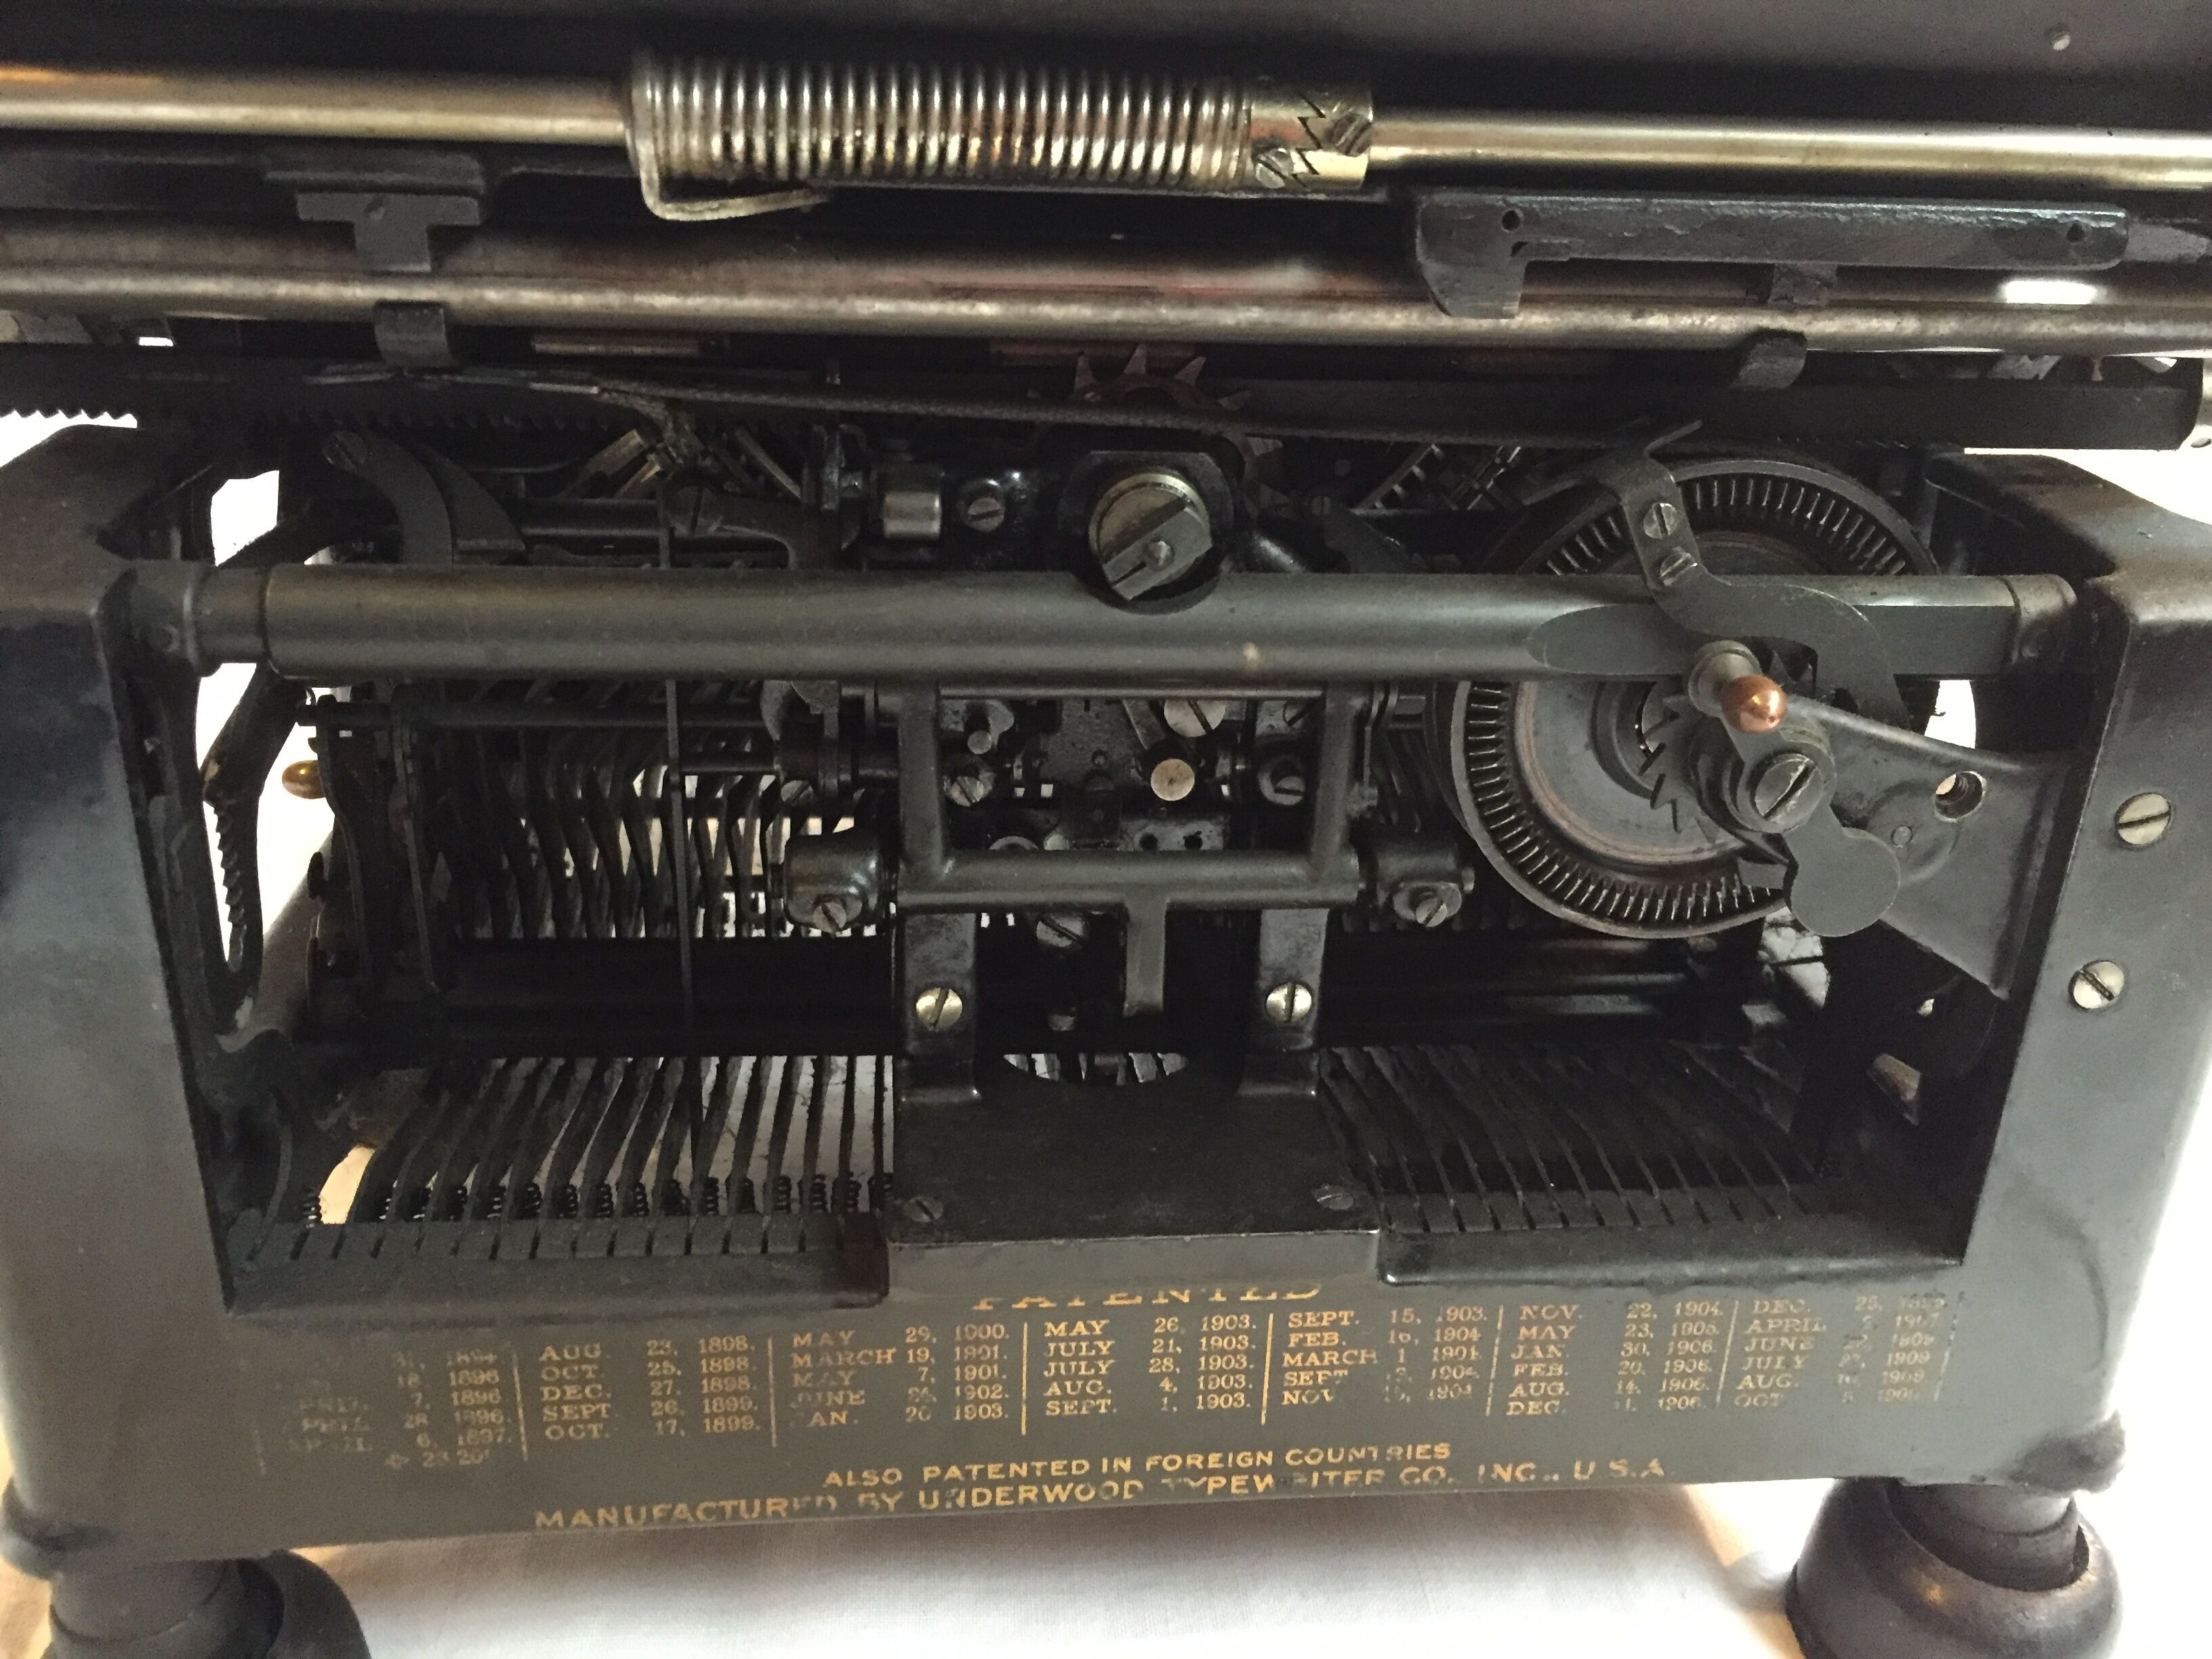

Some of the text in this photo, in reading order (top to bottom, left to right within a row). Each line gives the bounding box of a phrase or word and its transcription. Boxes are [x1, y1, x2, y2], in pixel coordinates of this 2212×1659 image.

[1519, 1303, 1583, 1322] NOV.
[1751, 1298, 1811, 1315] DEC.
[1044, 1319, 1110, 1338] MAY
[1201, 1314, 1257, 1332] 1903.
[1288, 1310, 1360, 1329] SEPT.
[1389, 1308, 1422, 1325] 15,
[1744, 1317, 1828, 1335] APRIL
[792, 1330, 855, 1348] MAY
[954, 1323, 1010, 1342] 1900.
[1288, 1331, 1347, 1349] FEB.
[1518, 1325, 1578, 1341] MAY
[1043, 1340, 1116, 1358] JULY
[1199, 1334, 1256, 1352] 1903.
[1743, 1335, 1818, 1353] JUNE
[790, 1347, 897, 1368] MARCH
[1043, 1359, 1115, 1378] JULY
[1198, 1354, 1254, 1372] 1903.
[1282, 1348, 1378, 1368] MARCH
[792, 1369, 856, 1387] MAY
[954, 1363, 1007, 1382] 1901.
[1513, 1362, 1570, 1378] FEB.
[1044, 1380, 1112, 1397] AUG.
[1197, 1374, 1254, 1391] 1903.
[1508, 1381, 1570, 1399] AUG.
[1735, 1374, 1799, 1391] AUG.
[792, 1410, 859, 1427] AN.
[954, 1403, 1009, 1421] 1903.
[1046, 1399, 1118, 1416] SEPT.
[1196, 1393, 1252, 1411] 1903.
[822, 1443, 1452, 1488] ALSO PATENTED IN FOREIGN COUNTRIES
[857, 1490, 904, 1513] BY
[918, 1479, 1145, 1511] UNDERWOOD
